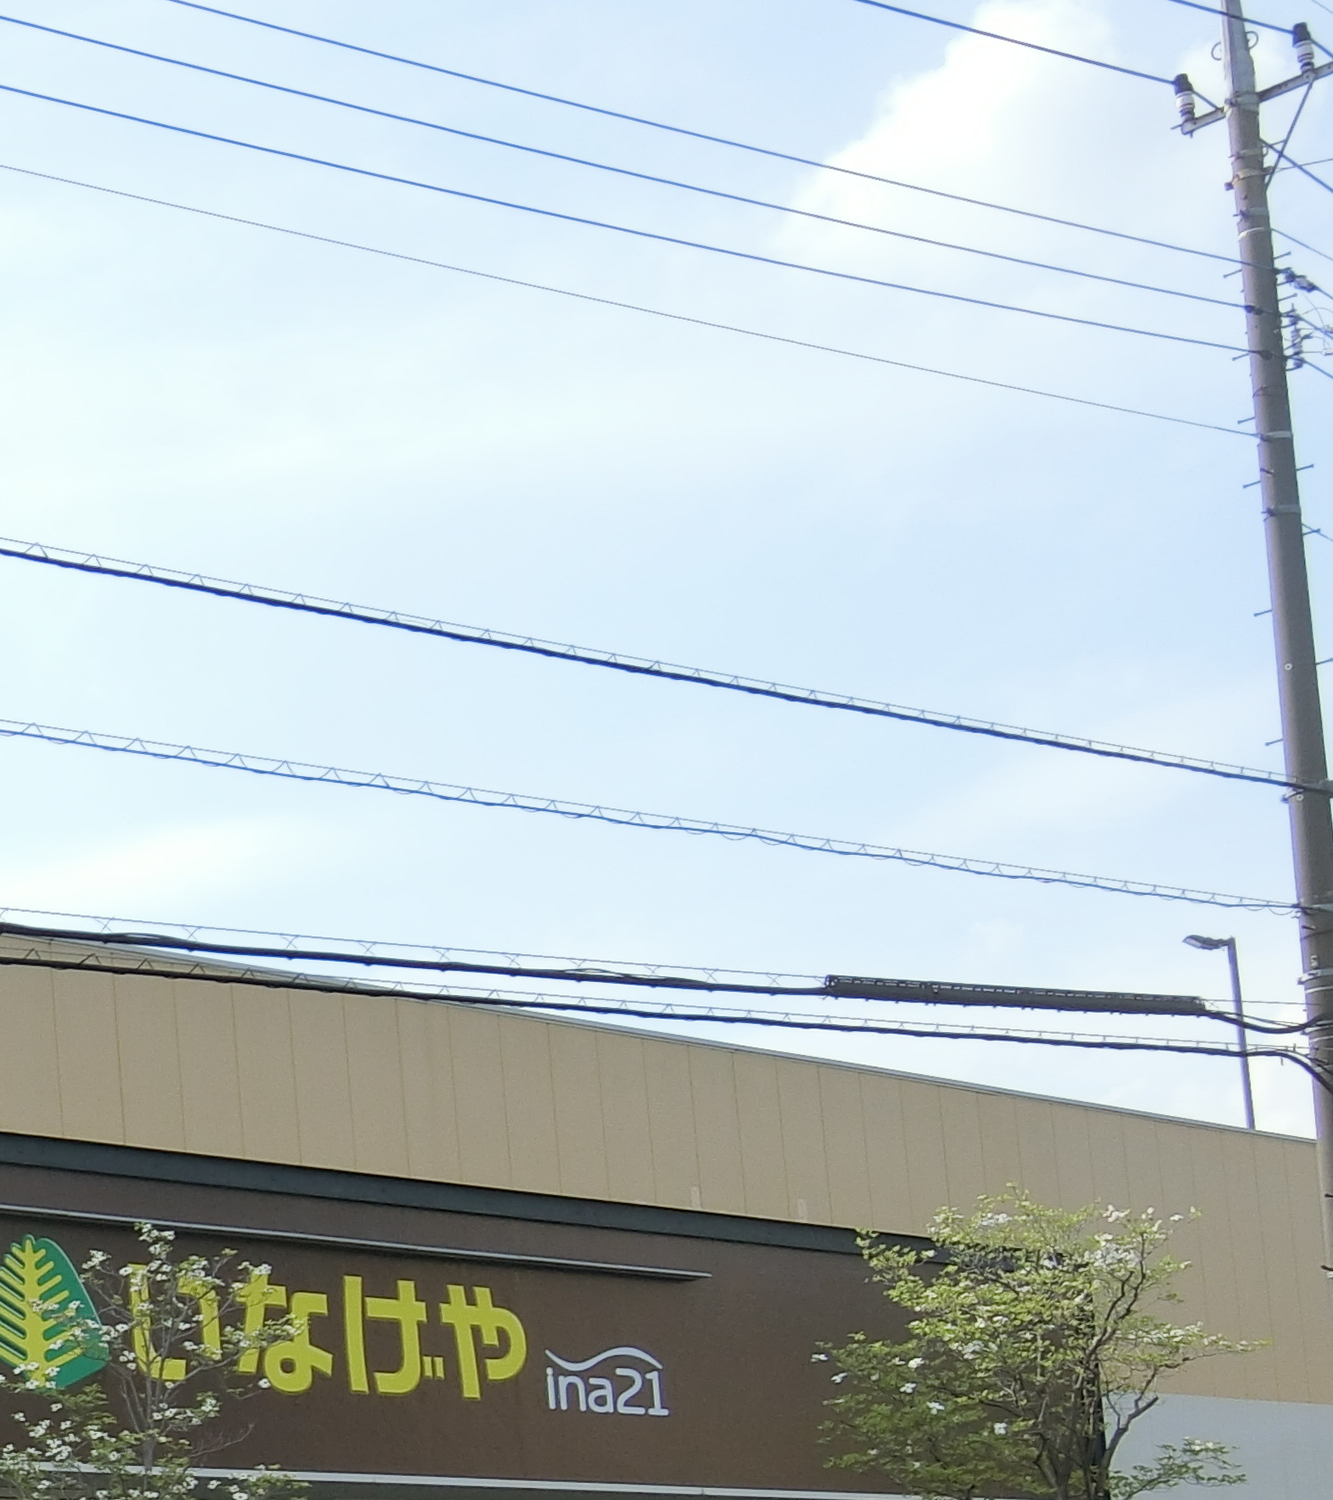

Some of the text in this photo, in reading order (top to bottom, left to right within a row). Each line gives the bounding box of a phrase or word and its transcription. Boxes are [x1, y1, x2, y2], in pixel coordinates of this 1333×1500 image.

[128, 1262, 526, 1399] いなげや
[546, 1365, 670, 1417] ina21
